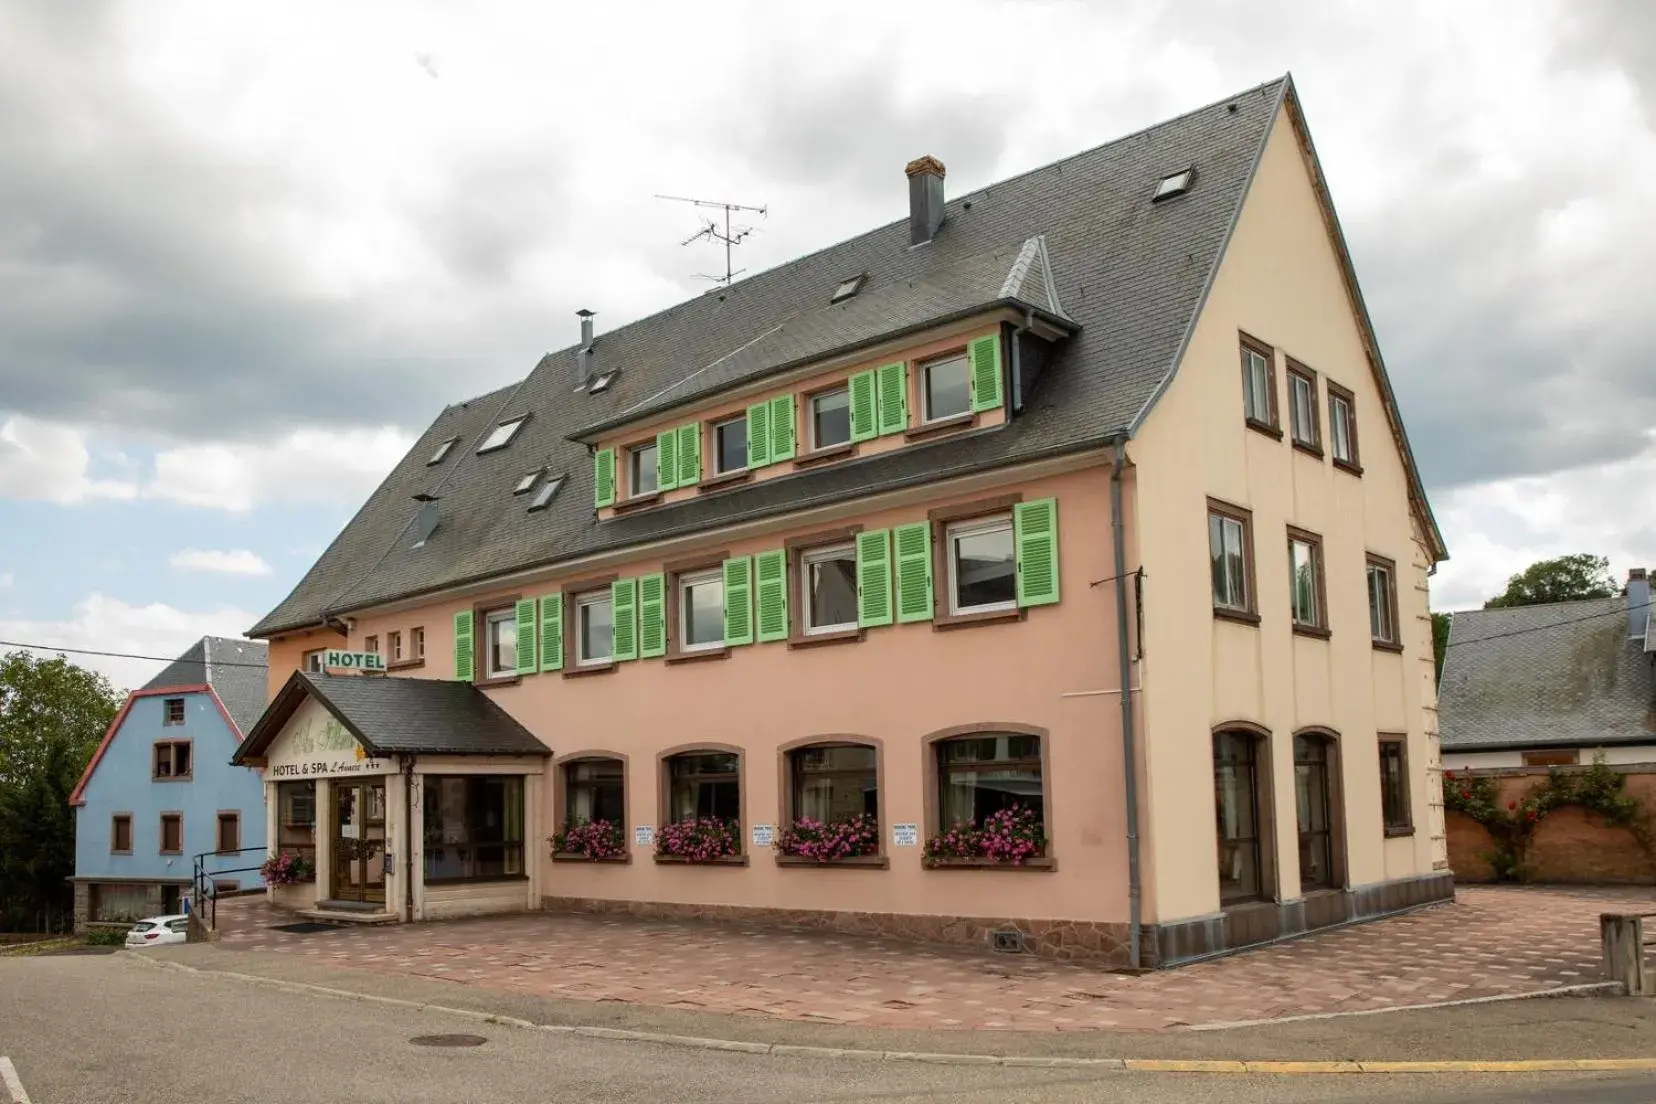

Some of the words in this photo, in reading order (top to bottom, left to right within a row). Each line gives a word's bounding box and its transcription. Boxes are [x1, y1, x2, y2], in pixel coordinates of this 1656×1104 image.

[328, 652, 385, 669] HOTEL
[273, 764, 300, 777] HOTEL
[301, 763, 309, 775] &
[311, 762, 328, 774] SPA
